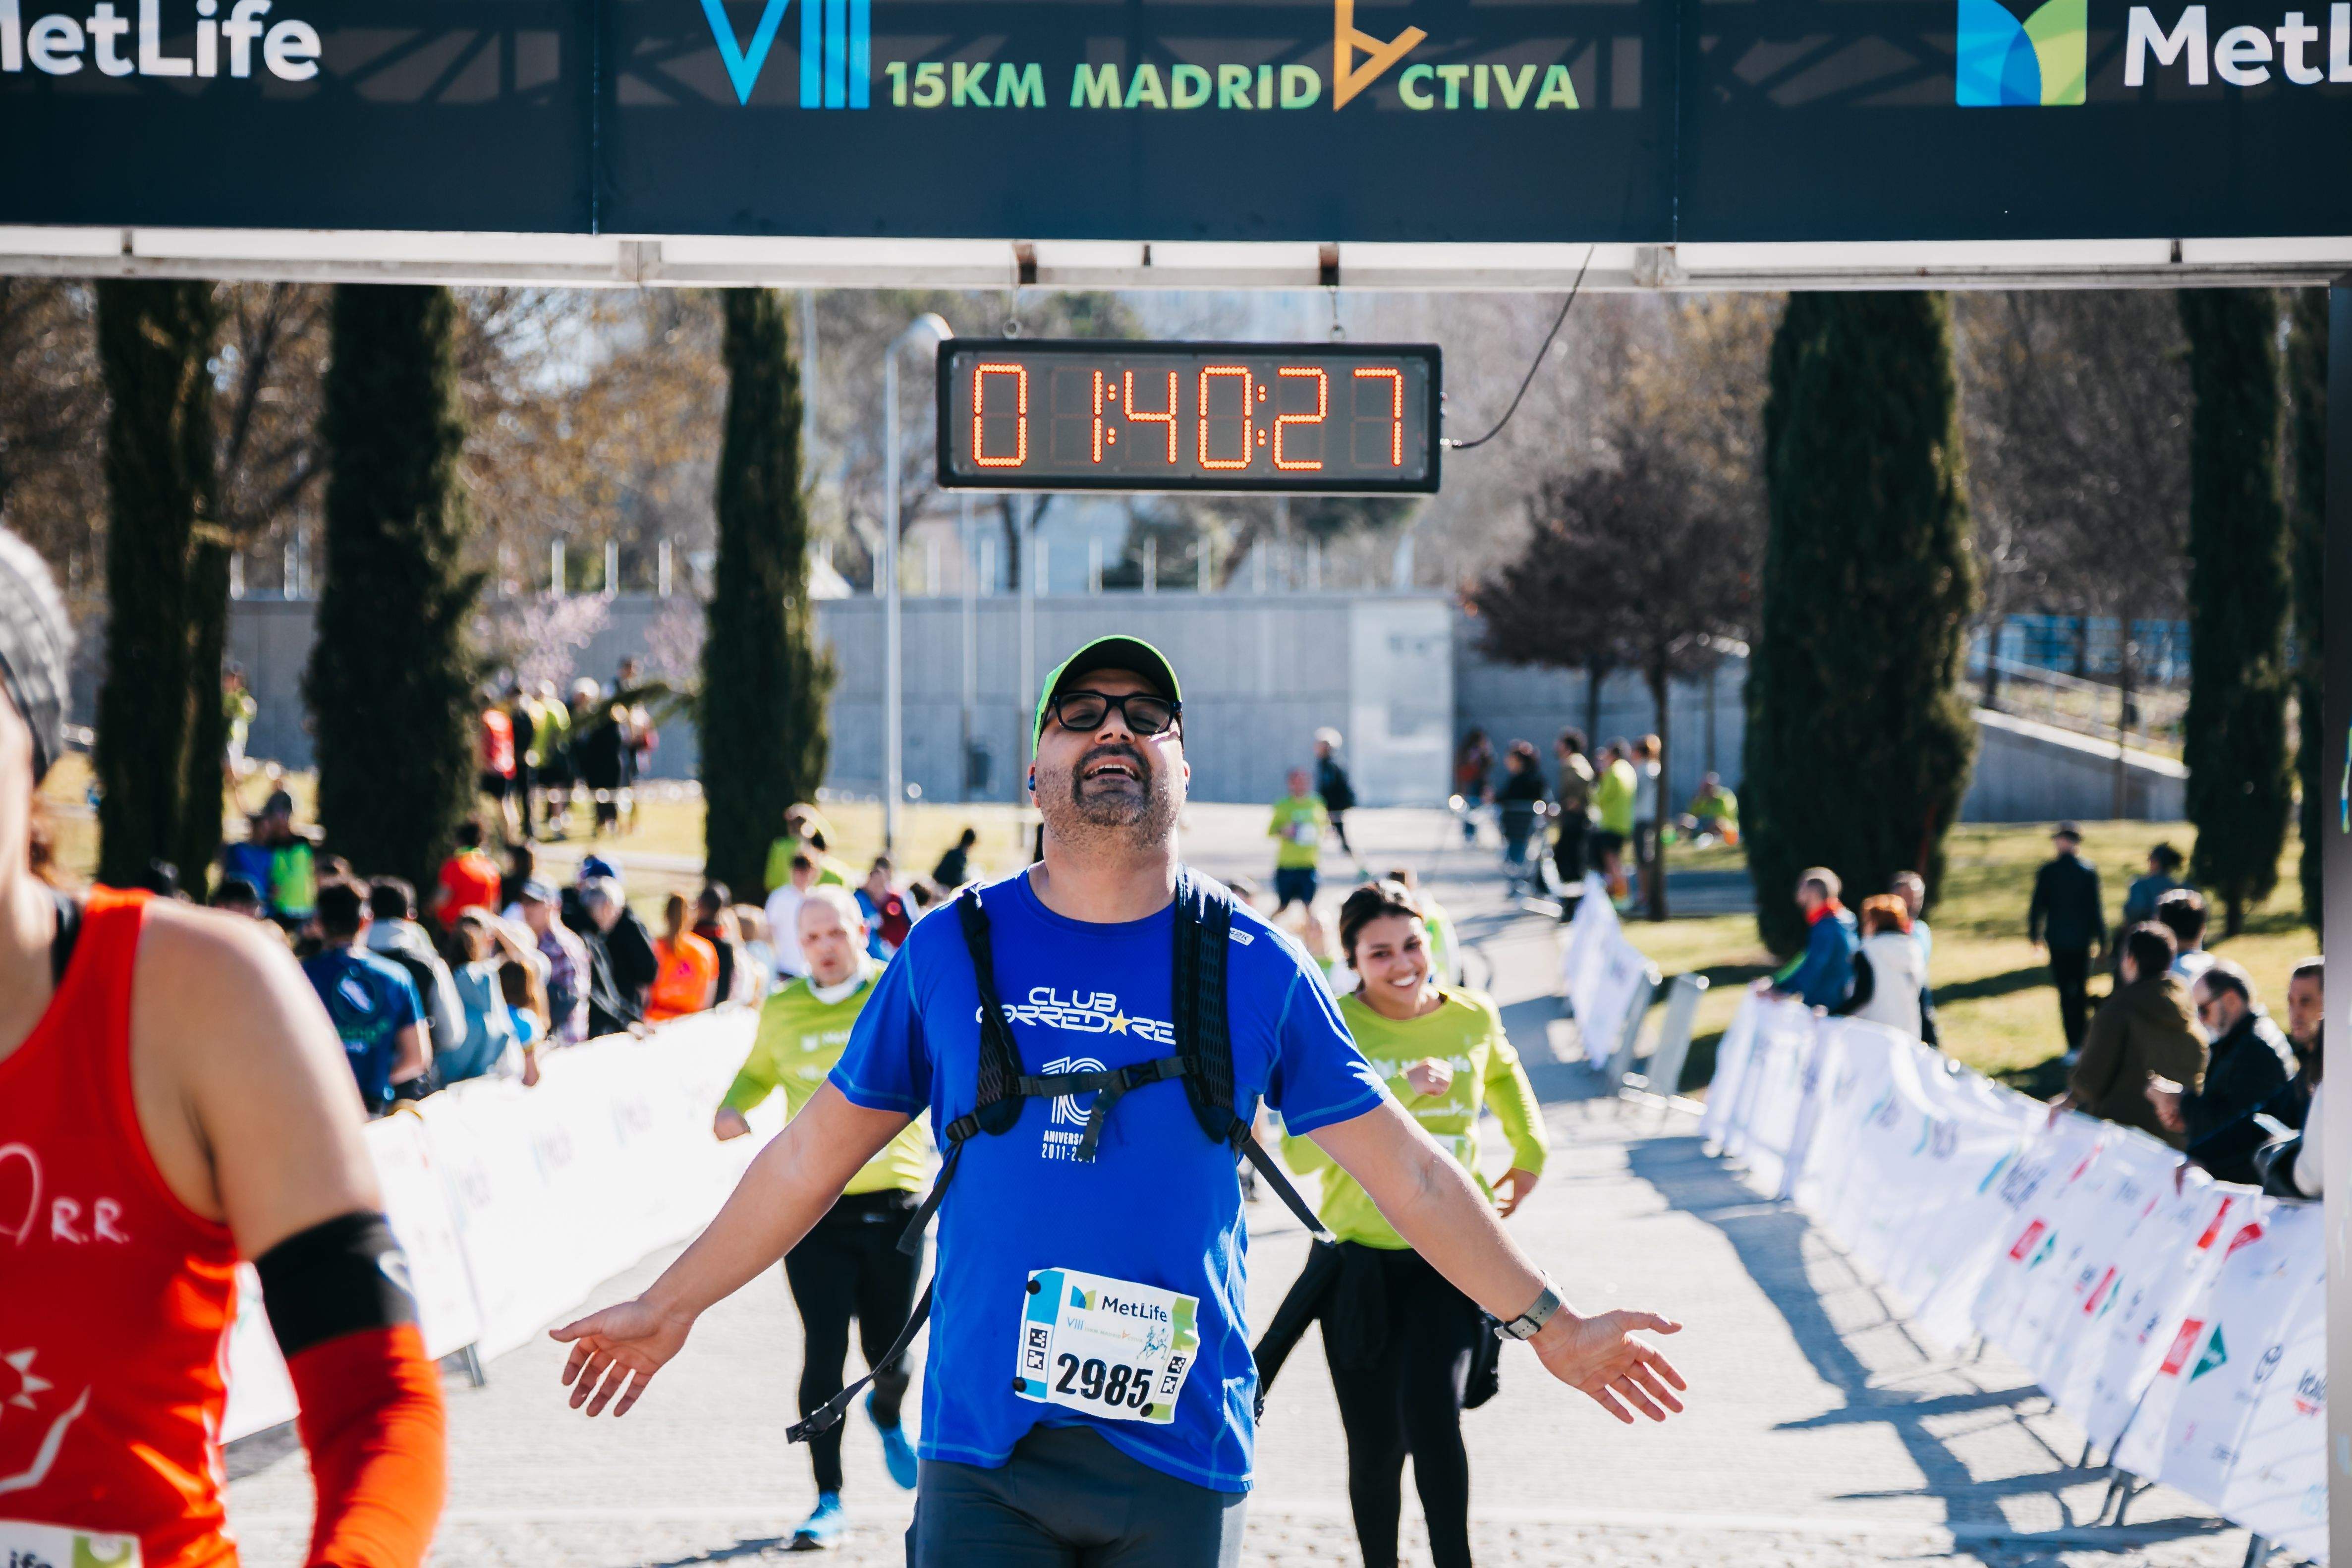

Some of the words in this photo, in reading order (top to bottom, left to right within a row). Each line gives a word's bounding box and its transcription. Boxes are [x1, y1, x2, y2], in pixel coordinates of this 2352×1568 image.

[0, 0, 322, 81] etLife
[701, 0, 871, 110] VIII
[885, 61, 1047, 108] 15KM
[1069, 63, 1322, 110] MADRID
[973, 363, 1403, 470] 01:40:27
[1028, 987, 1117, 1012] CLUB
[1102, 1295, 1167, 1323] MetLife
[1055, 1353, 1153, 1409] 2985
